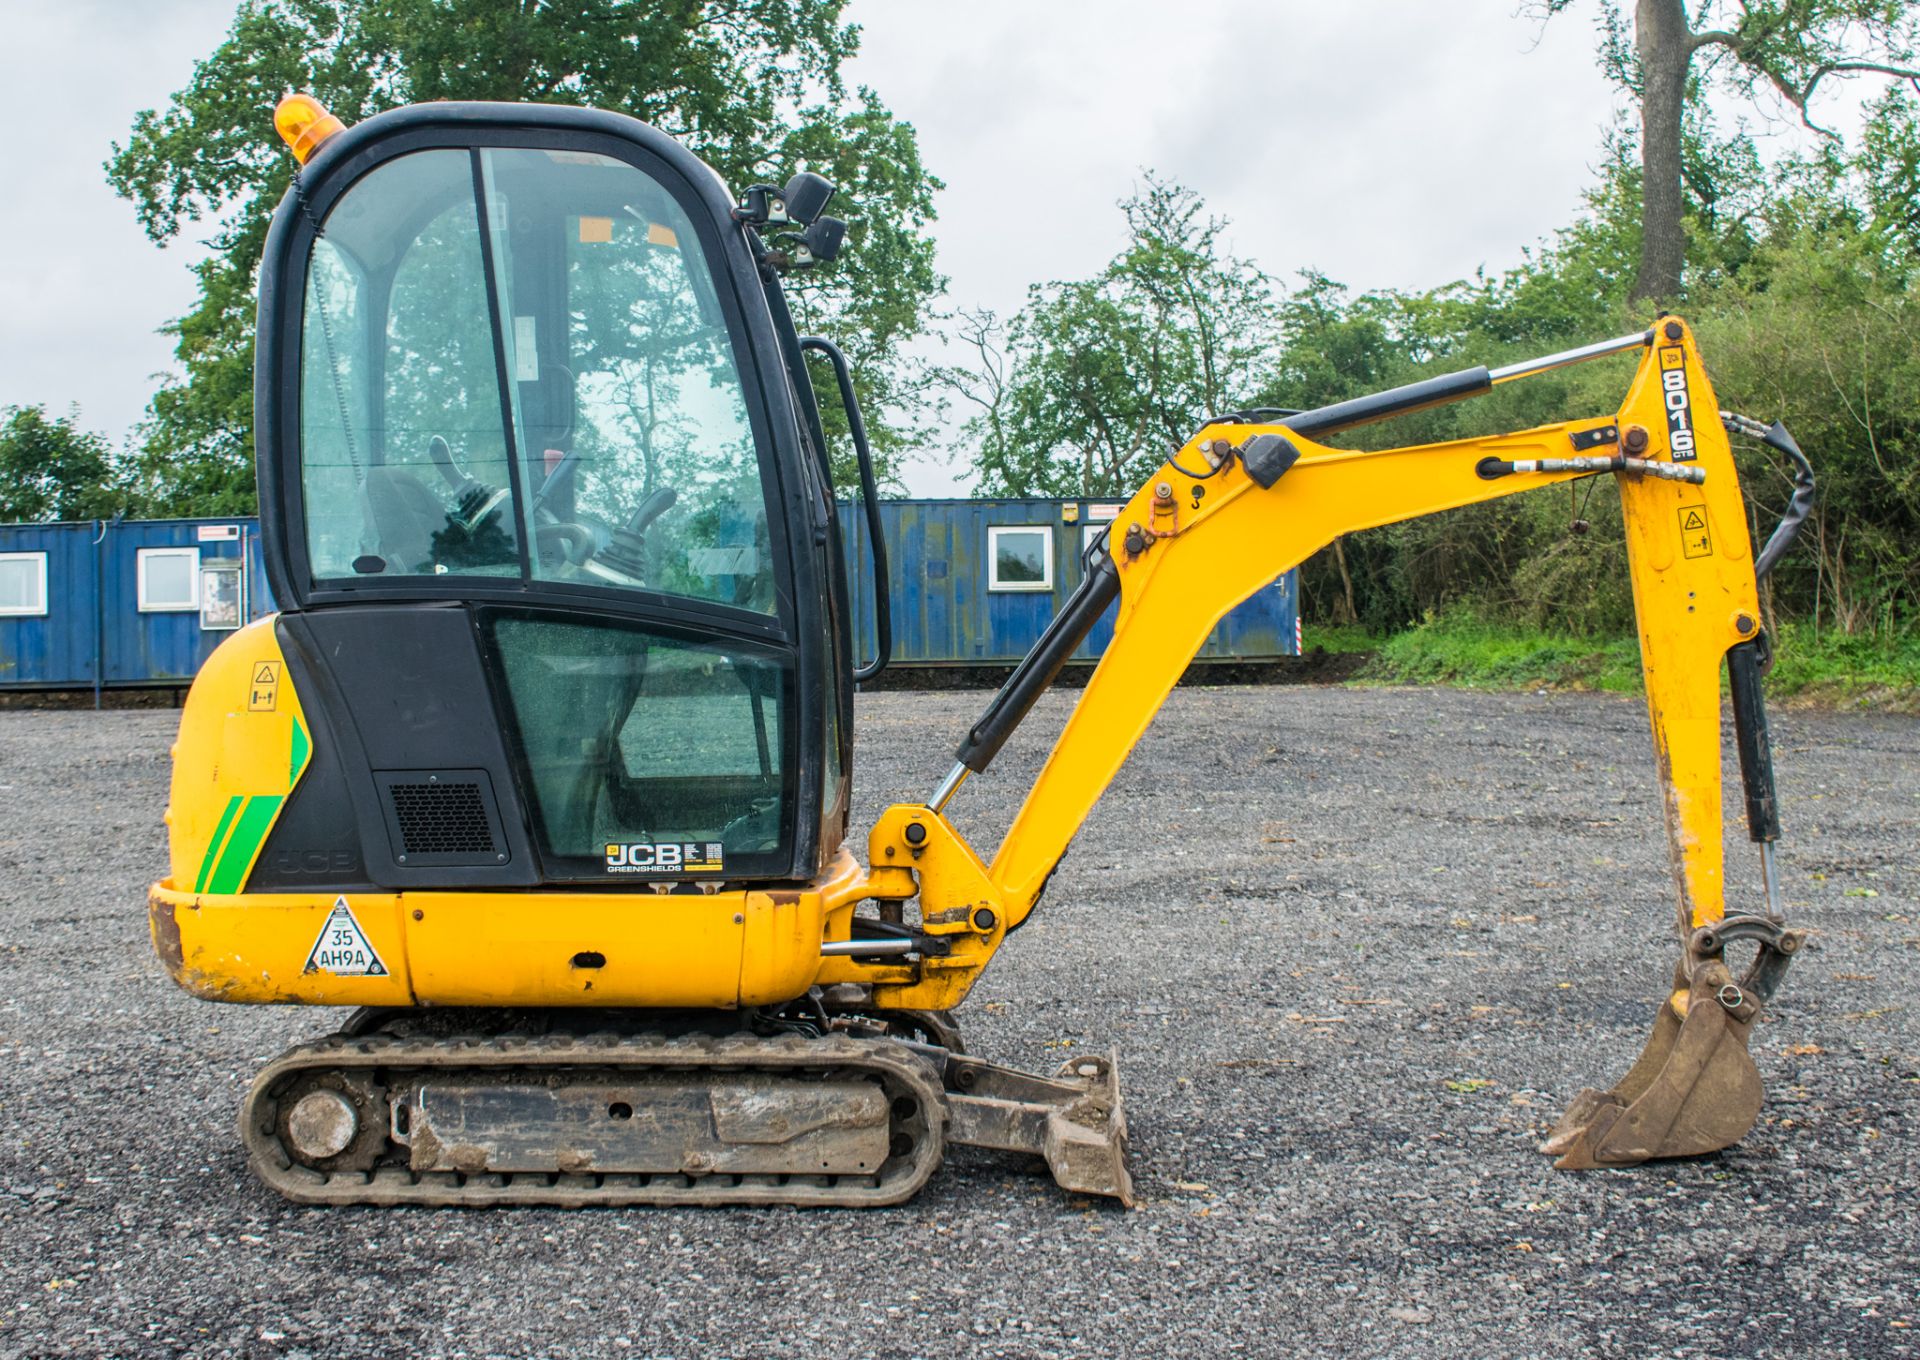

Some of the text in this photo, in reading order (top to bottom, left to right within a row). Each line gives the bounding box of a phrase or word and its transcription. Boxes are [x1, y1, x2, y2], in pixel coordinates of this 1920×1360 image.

[1662, 369, 1694, 451] 8016
[277, 849, 358, 874] JCB
[607, 844, 682, 866] JCB
[607, 865, 682, 873] GREENSHIELDS
[332, 929, 353, 946] 35
[320, 950, 366, 967] AH9A
